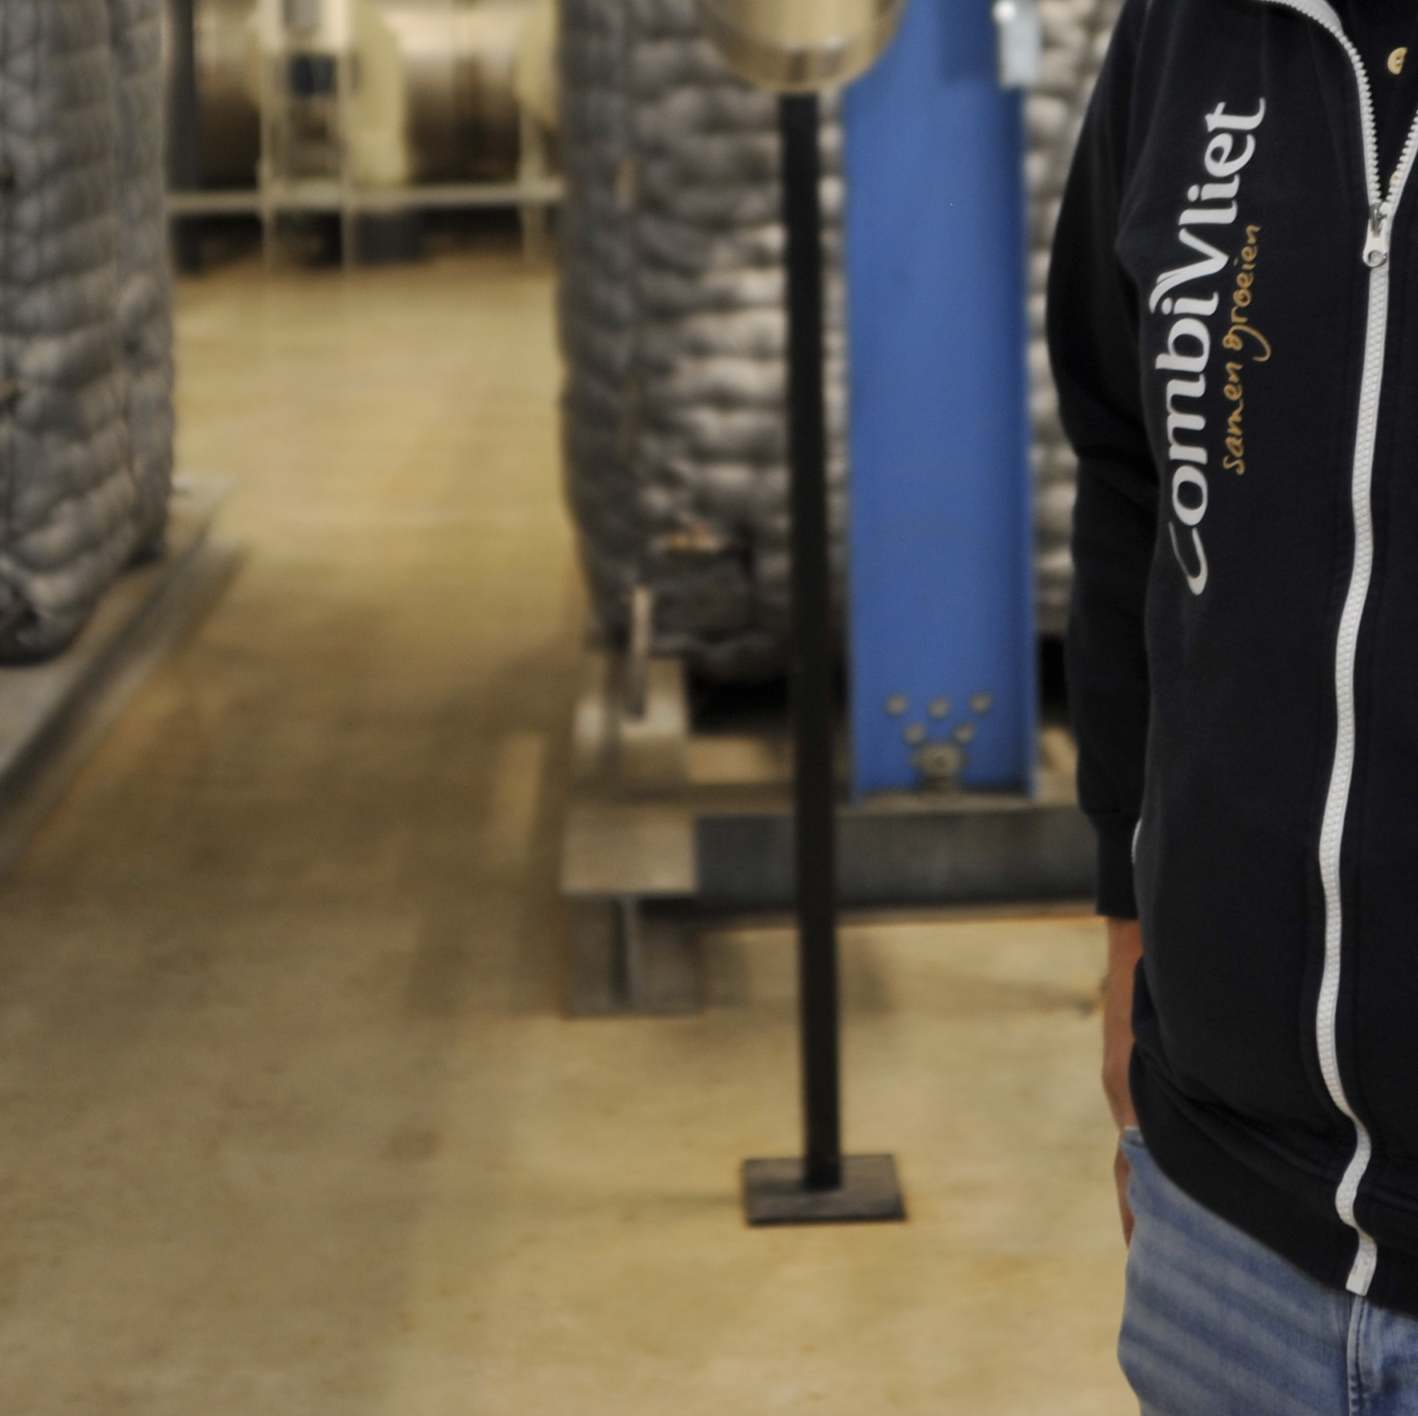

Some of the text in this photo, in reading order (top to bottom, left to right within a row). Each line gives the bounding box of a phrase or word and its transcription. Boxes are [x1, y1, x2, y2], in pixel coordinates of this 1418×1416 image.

[1148, 96, 1266, 596] CombiVliet
[1222, 224, 1272, 475] samen groeien
